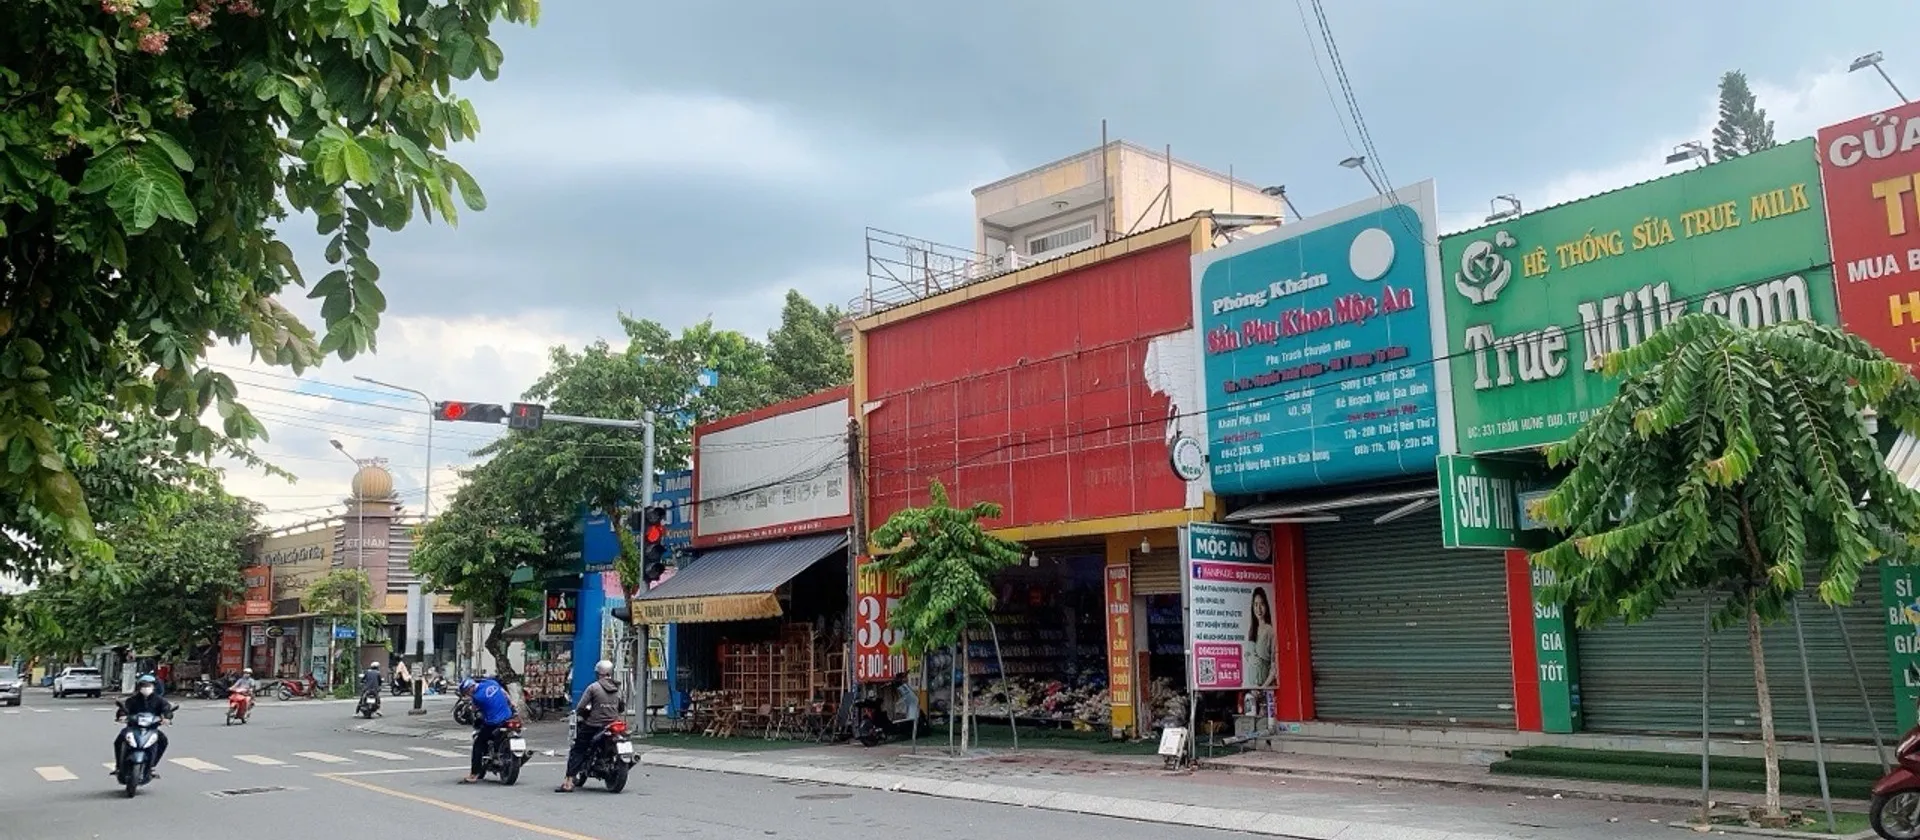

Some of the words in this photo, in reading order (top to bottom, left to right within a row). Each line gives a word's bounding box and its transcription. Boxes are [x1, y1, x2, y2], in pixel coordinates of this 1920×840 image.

[1522, 245, 1550, 278] HỆ
[1556, 227, 1624, 269] THỐNG
[1632, 216, 1675, 250] SỮA
[1680, 201, 1740, 239] TRUE
[1750, 184, 1811, 223] MILK
[1848, 254, 1900, 283] MUA
[1212, 291, 1268, 315] Phòng
[1269, 271, 1329, 299] Khám
[1207, 323, 1241, 353] Sản
[1242, 318, 1279, 346] Phụ
[1280, 307, 1334, 337] Khoa
[1335, 291, 1378, 326] Mộc
[1382, 284, 1414, 316] An
[1464, 324, 1568, 391] True
[1457, 465, 1490, 529] SIÊU
[1491, 478, 1514, 541] THỊ
[1196, 535, 1227, 559] MỘC
[1230, 541, 1248, 558] AN
[1114, 581, 1123, 601] 1
[1115, 616, 1125, 637] 1
[1541, 631, 1563, 651] GIÁ
[858, 653, 866, 678] 3
[1540, 660, 1564, 681] TỐT
